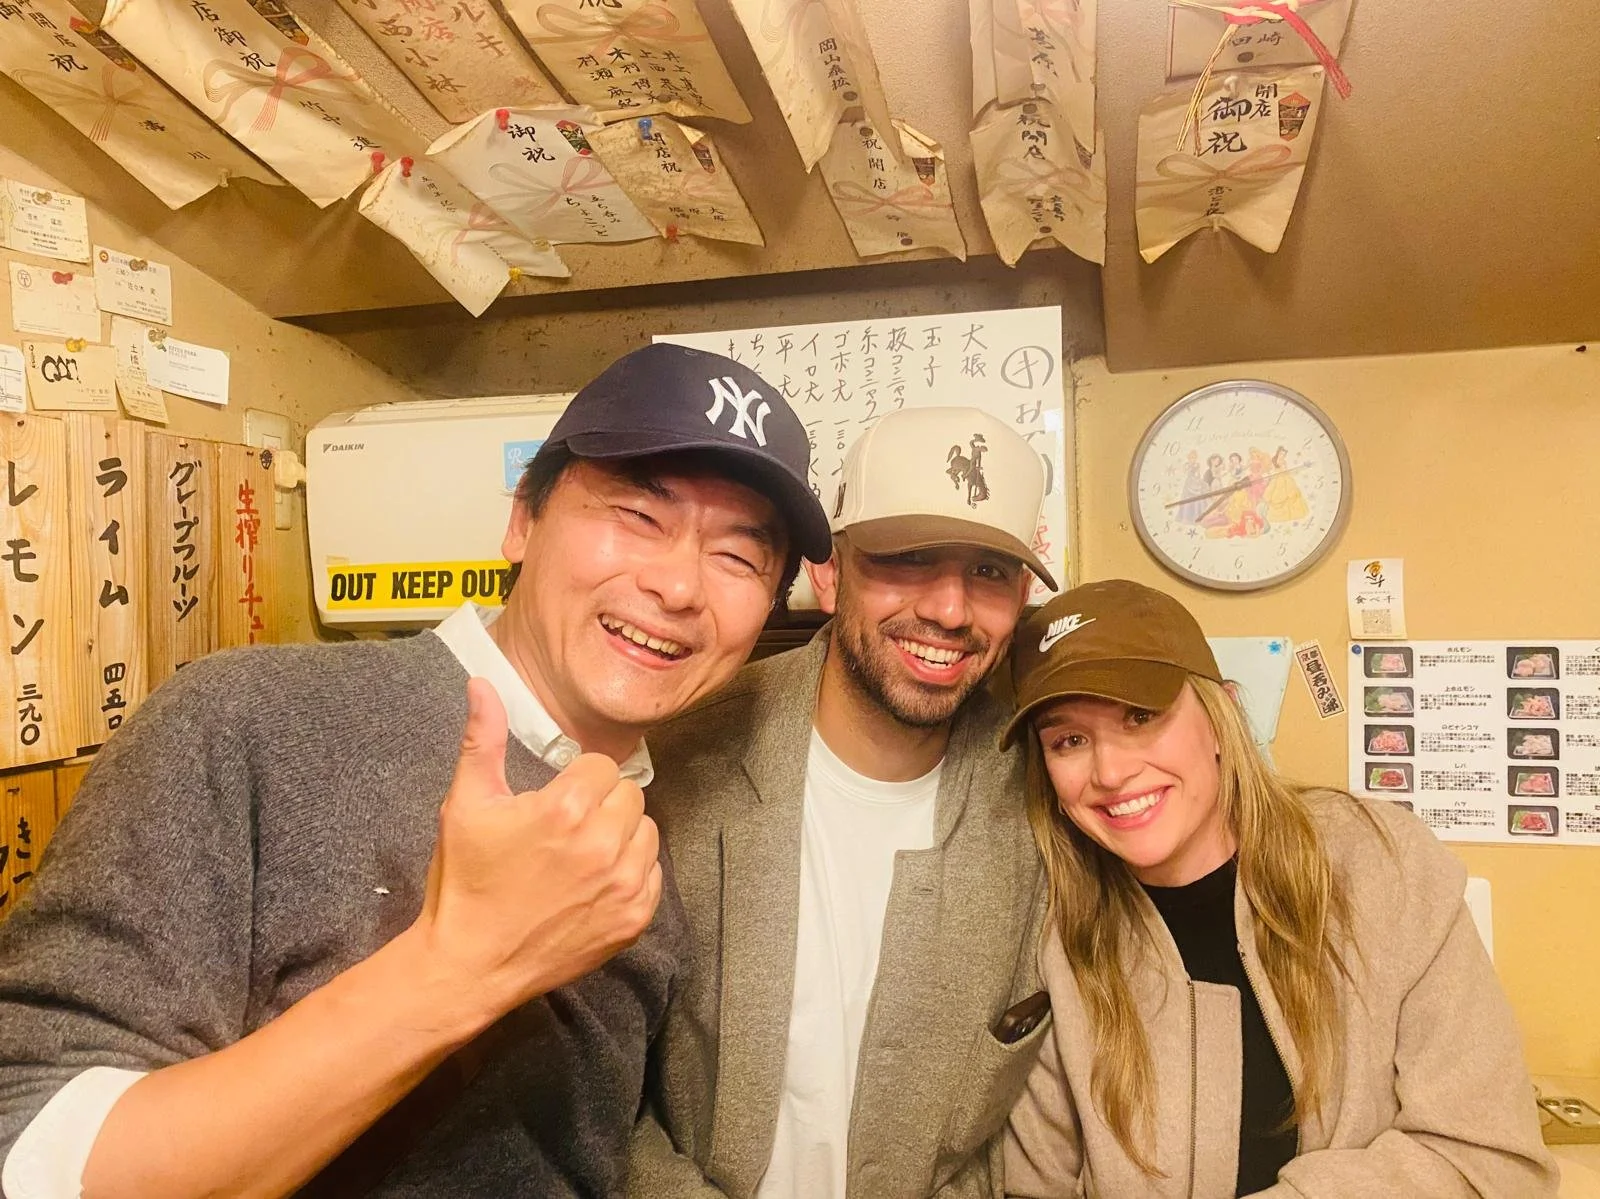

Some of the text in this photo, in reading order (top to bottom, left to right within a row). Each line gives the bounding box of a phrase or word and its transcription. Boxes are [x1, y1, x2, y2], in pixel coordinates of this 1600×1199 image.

[1250, 83, 1278, 118] 開店
[507, 124, 556, 163] 御祝
[1201, 96, 1251, 157] 御祝
[862, 138, 887, 190] 祝開店
[922, 326, 942, 388] 玉子
[705, 376, 771, 447] NY
[1225, 402, 1246, 418] 12
[331, 443, 364, 452] DAIKIN
[1162, 441, 1181, 457] 10
[96, 457, 129, 608] ライム
[169, 459, 202, 622] グレープフルーツ
[1, 460, 44, 655] レモン
[1233, 554, 1244, 570] 6
[331, 572, 376, 601] OUT
[391, 570, 453, 600] KEEP
[1046, 613, 1083, 639] NIKE
